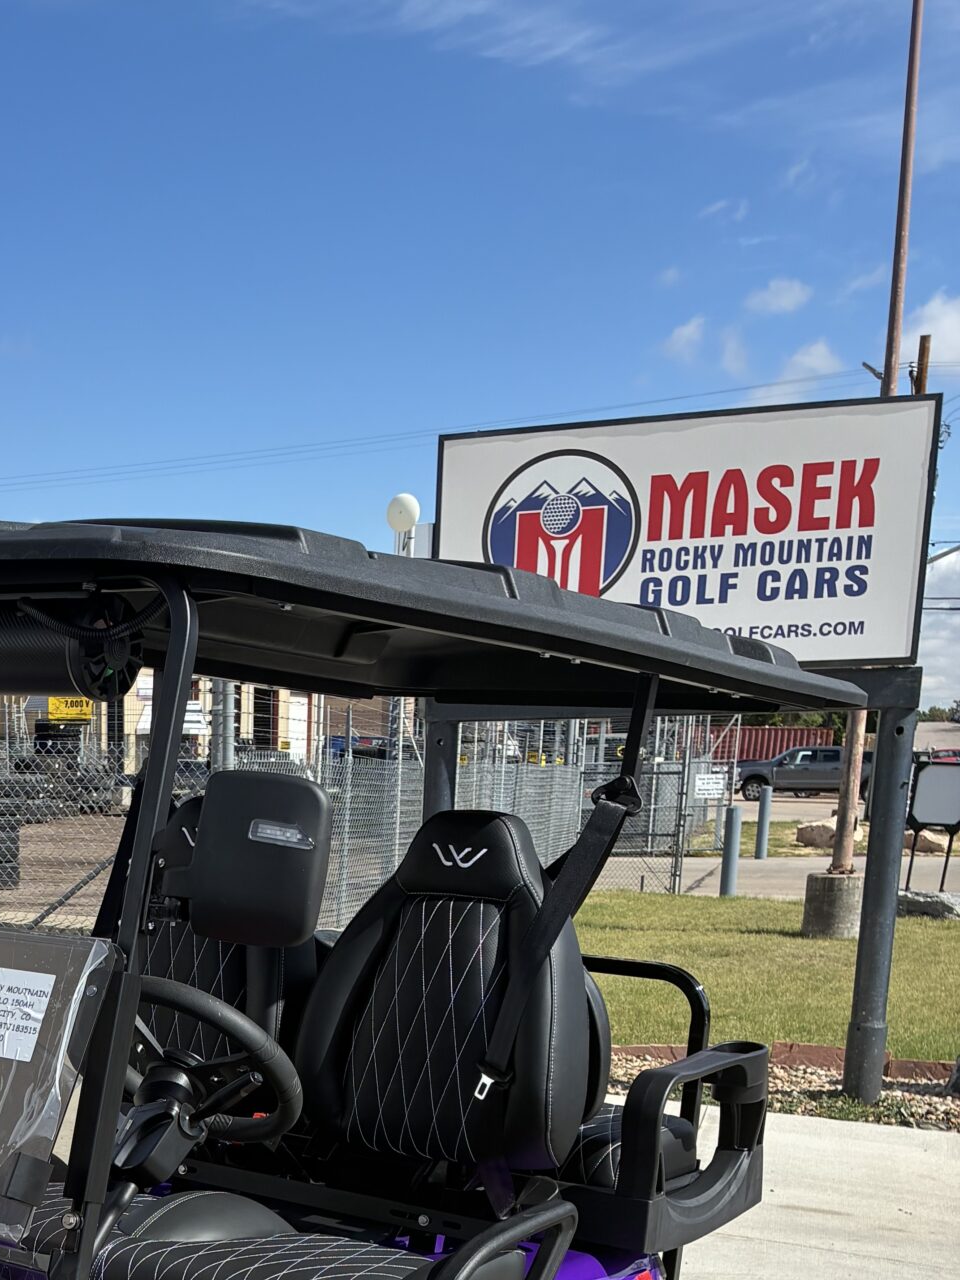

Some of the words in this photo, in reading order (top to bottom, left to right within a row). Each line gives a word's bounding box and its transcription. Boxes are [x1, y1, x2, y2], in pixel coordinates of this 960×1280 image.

[646, 457, 881, 542] MASEK
[641, 542, 726, 574] ROCKY
[733, 534, 874, 569] MOUNTAIN
[640, 572, 739, 608] GOLF
[756, 564, 869, 602] CARS
[713, 620, 865, 640] OLFCARS.COM
[64, 699, 84, 709] 7,000
[6, 985, 49, 999] MOUTNAIN
[11, 998, 35, 1009] 150AH
[20, 1012, 31, 1021] CO
